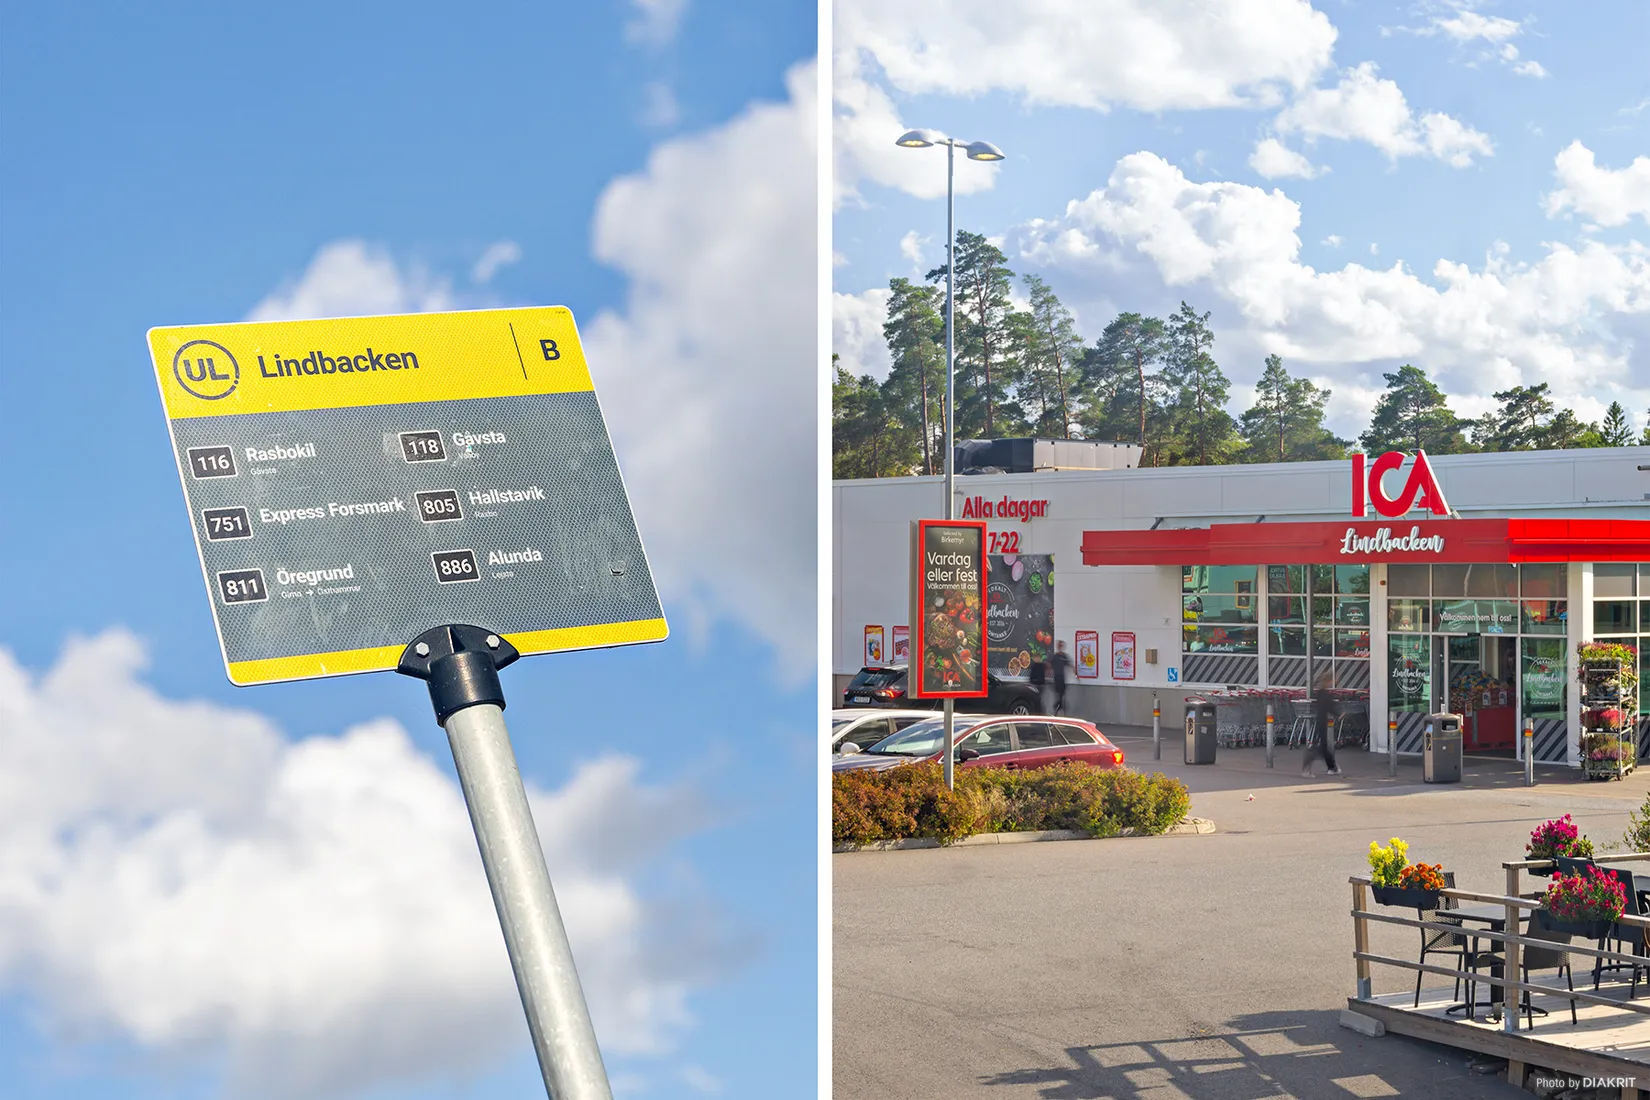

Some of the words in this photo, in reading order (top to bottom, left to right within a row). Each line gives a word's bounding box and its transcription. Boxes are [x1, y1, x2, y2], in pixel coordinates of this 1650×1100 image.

[539, 339, 561, 361] B
[183, 357, 230, 382] UL
[257, 348, 420, 378] Lindbacken
[409, 439, 439, 456] 118
[453, 430, 507, 447] Gåvsta
[245, 442, 317, 462] Rasbokil
[198, 454, 230, 471] 116
[1352, 449, 1452, 518] ICA
[468, 485, 546, 506] Hallstavik
[260, 506, 325, 526] Express
[328, 497, 407, 518] Forsmark
[423, 498, 456, 515] 805
[961, 496, 994, 519] Alla
[996, 495, 1049, 523] dagar
[210, 516, 243, 533] 751
[988, 530, 1020, 554] 7-22
[1340, 525, 1446, 555] Lindbacken
[488, 547, 543, 566] Alunda
[927, 551, 971, 569] Vardag
[276, 564, 354, 586] Öregrund
[440, 558, 473, 576] 886
[927, 568, 953, 582] eller
[956, 568, 978, 582] fest
[226, 578, 260, 596] 811
[943, 671, 961, 683] ICA
